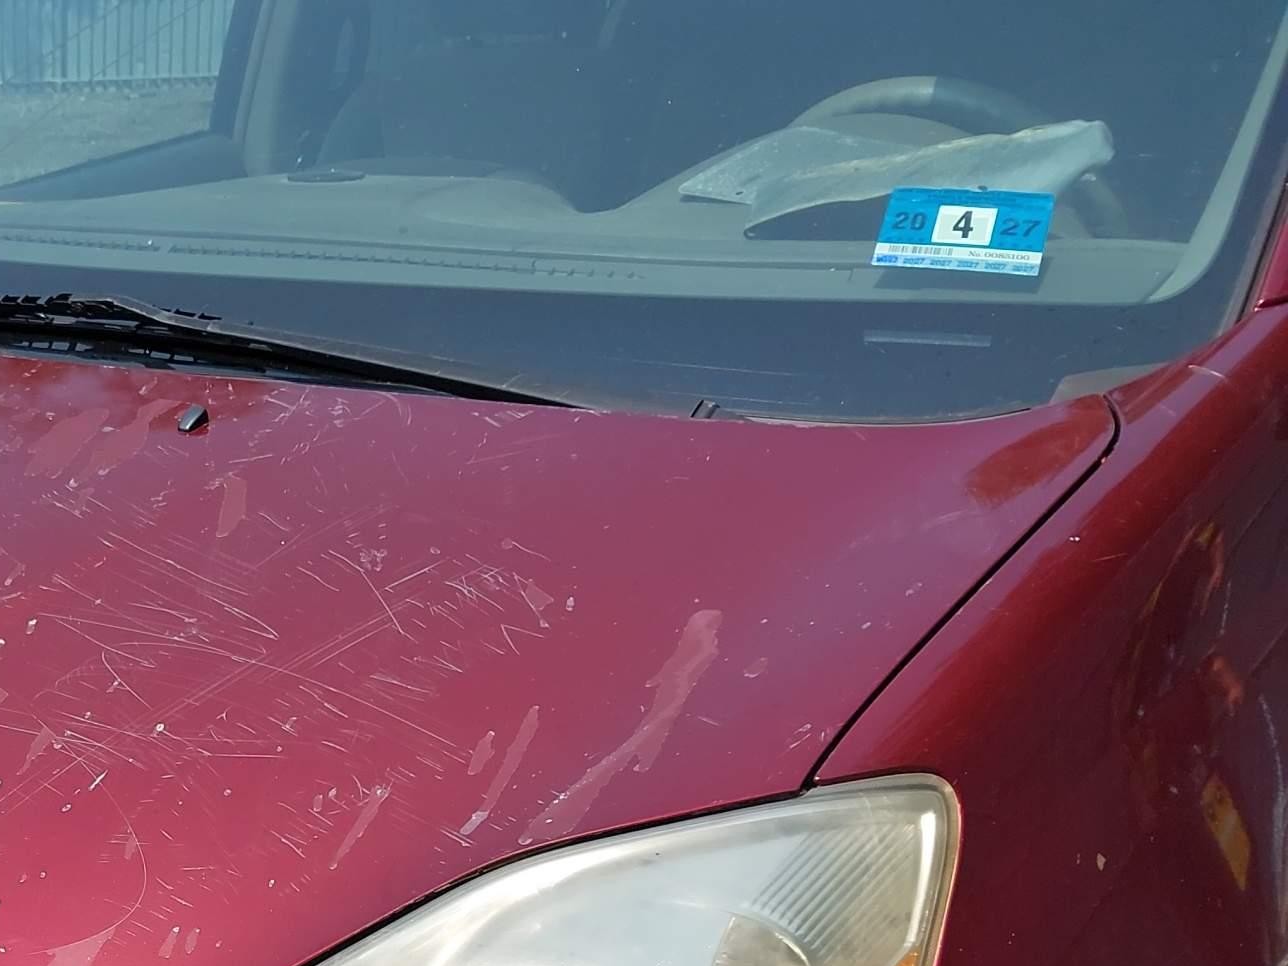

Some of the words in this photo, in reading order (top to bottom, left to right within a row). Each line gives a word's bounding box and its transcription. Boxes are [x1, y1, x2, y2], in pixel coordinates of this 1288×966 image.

[893, 211, 927, 231] 20
[952, 210, 973, 238] 4
[1000, 218, 1041, 238] 27
